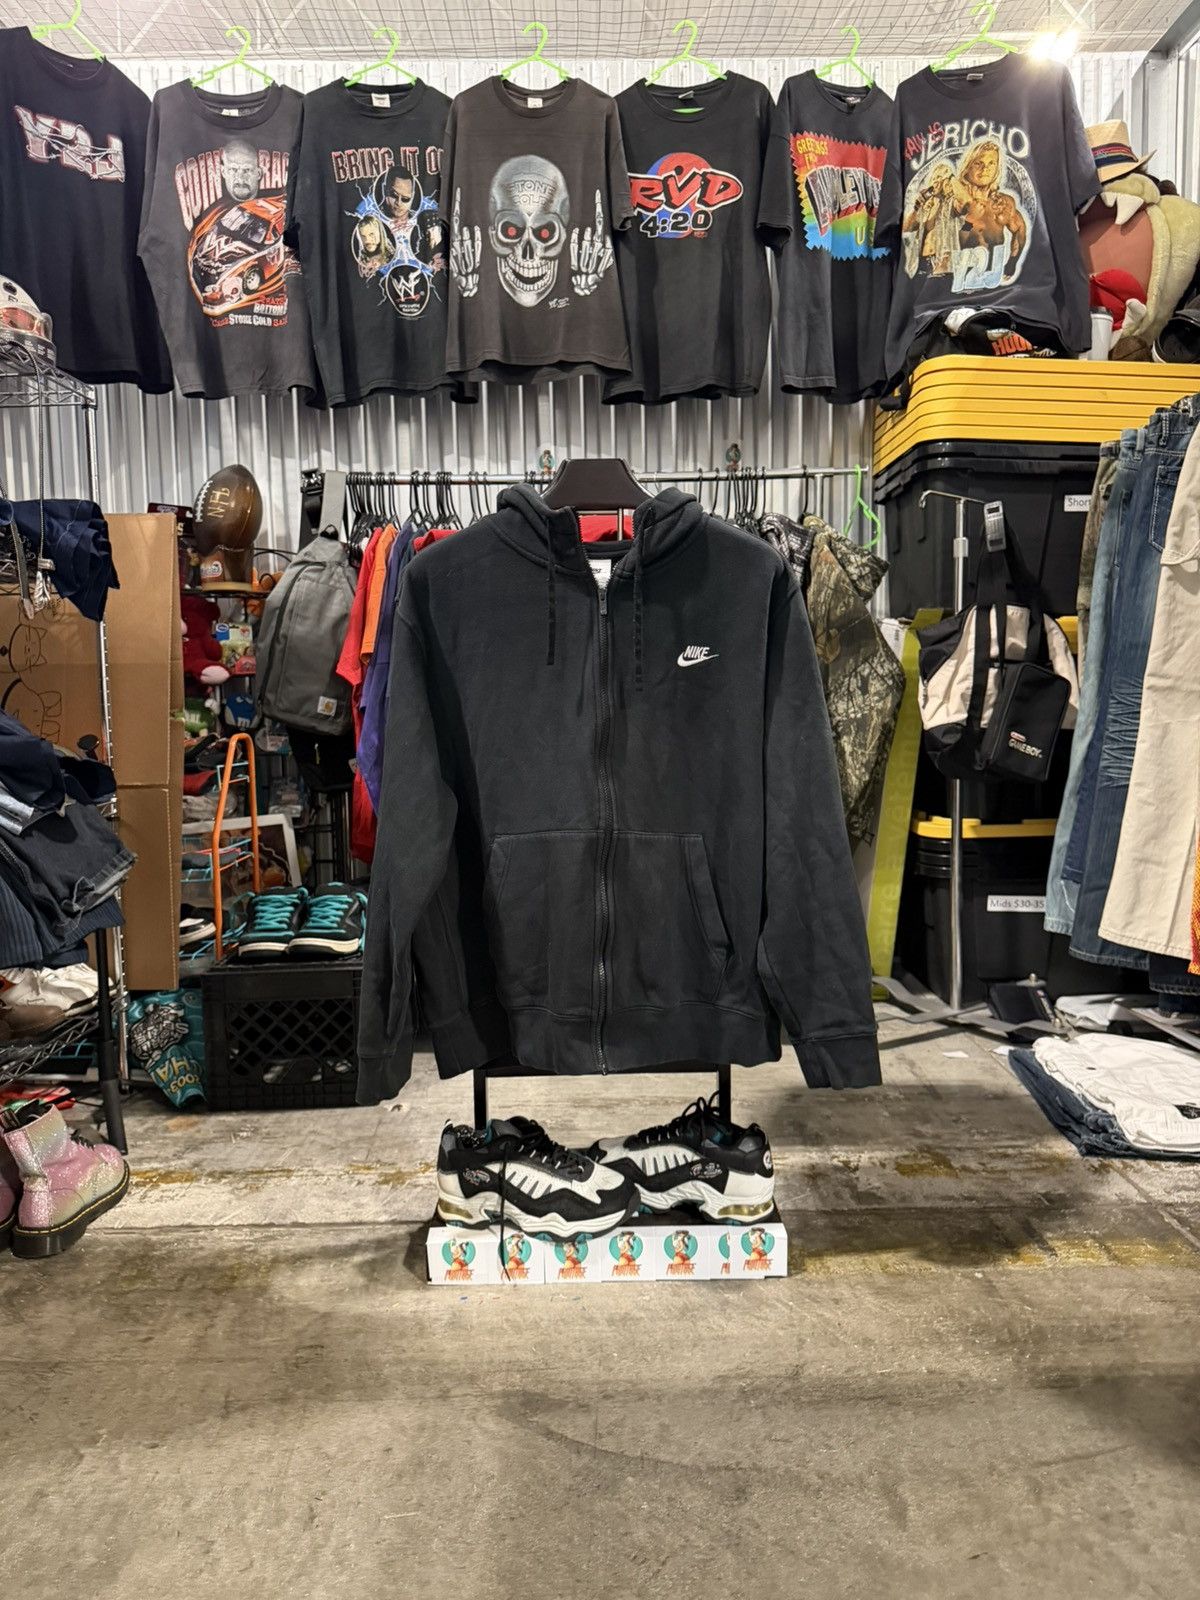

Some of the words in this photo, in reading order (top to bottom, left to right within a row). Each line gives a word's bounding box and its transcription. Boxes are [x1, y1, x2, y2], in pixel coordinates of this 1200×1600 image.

[910, 118, 1030, 171] JERICHO
[331, 147, 394, 183] BRING
[400, 146, 420, 177] IT
[511, 179, 556, 197] STONE
[628, 167, 744, 216] RVD
[640, 209, 712, 238] 4:20
[684, 645, 710, 659] NIKE
[990, 899, 1012, 908] Mids
